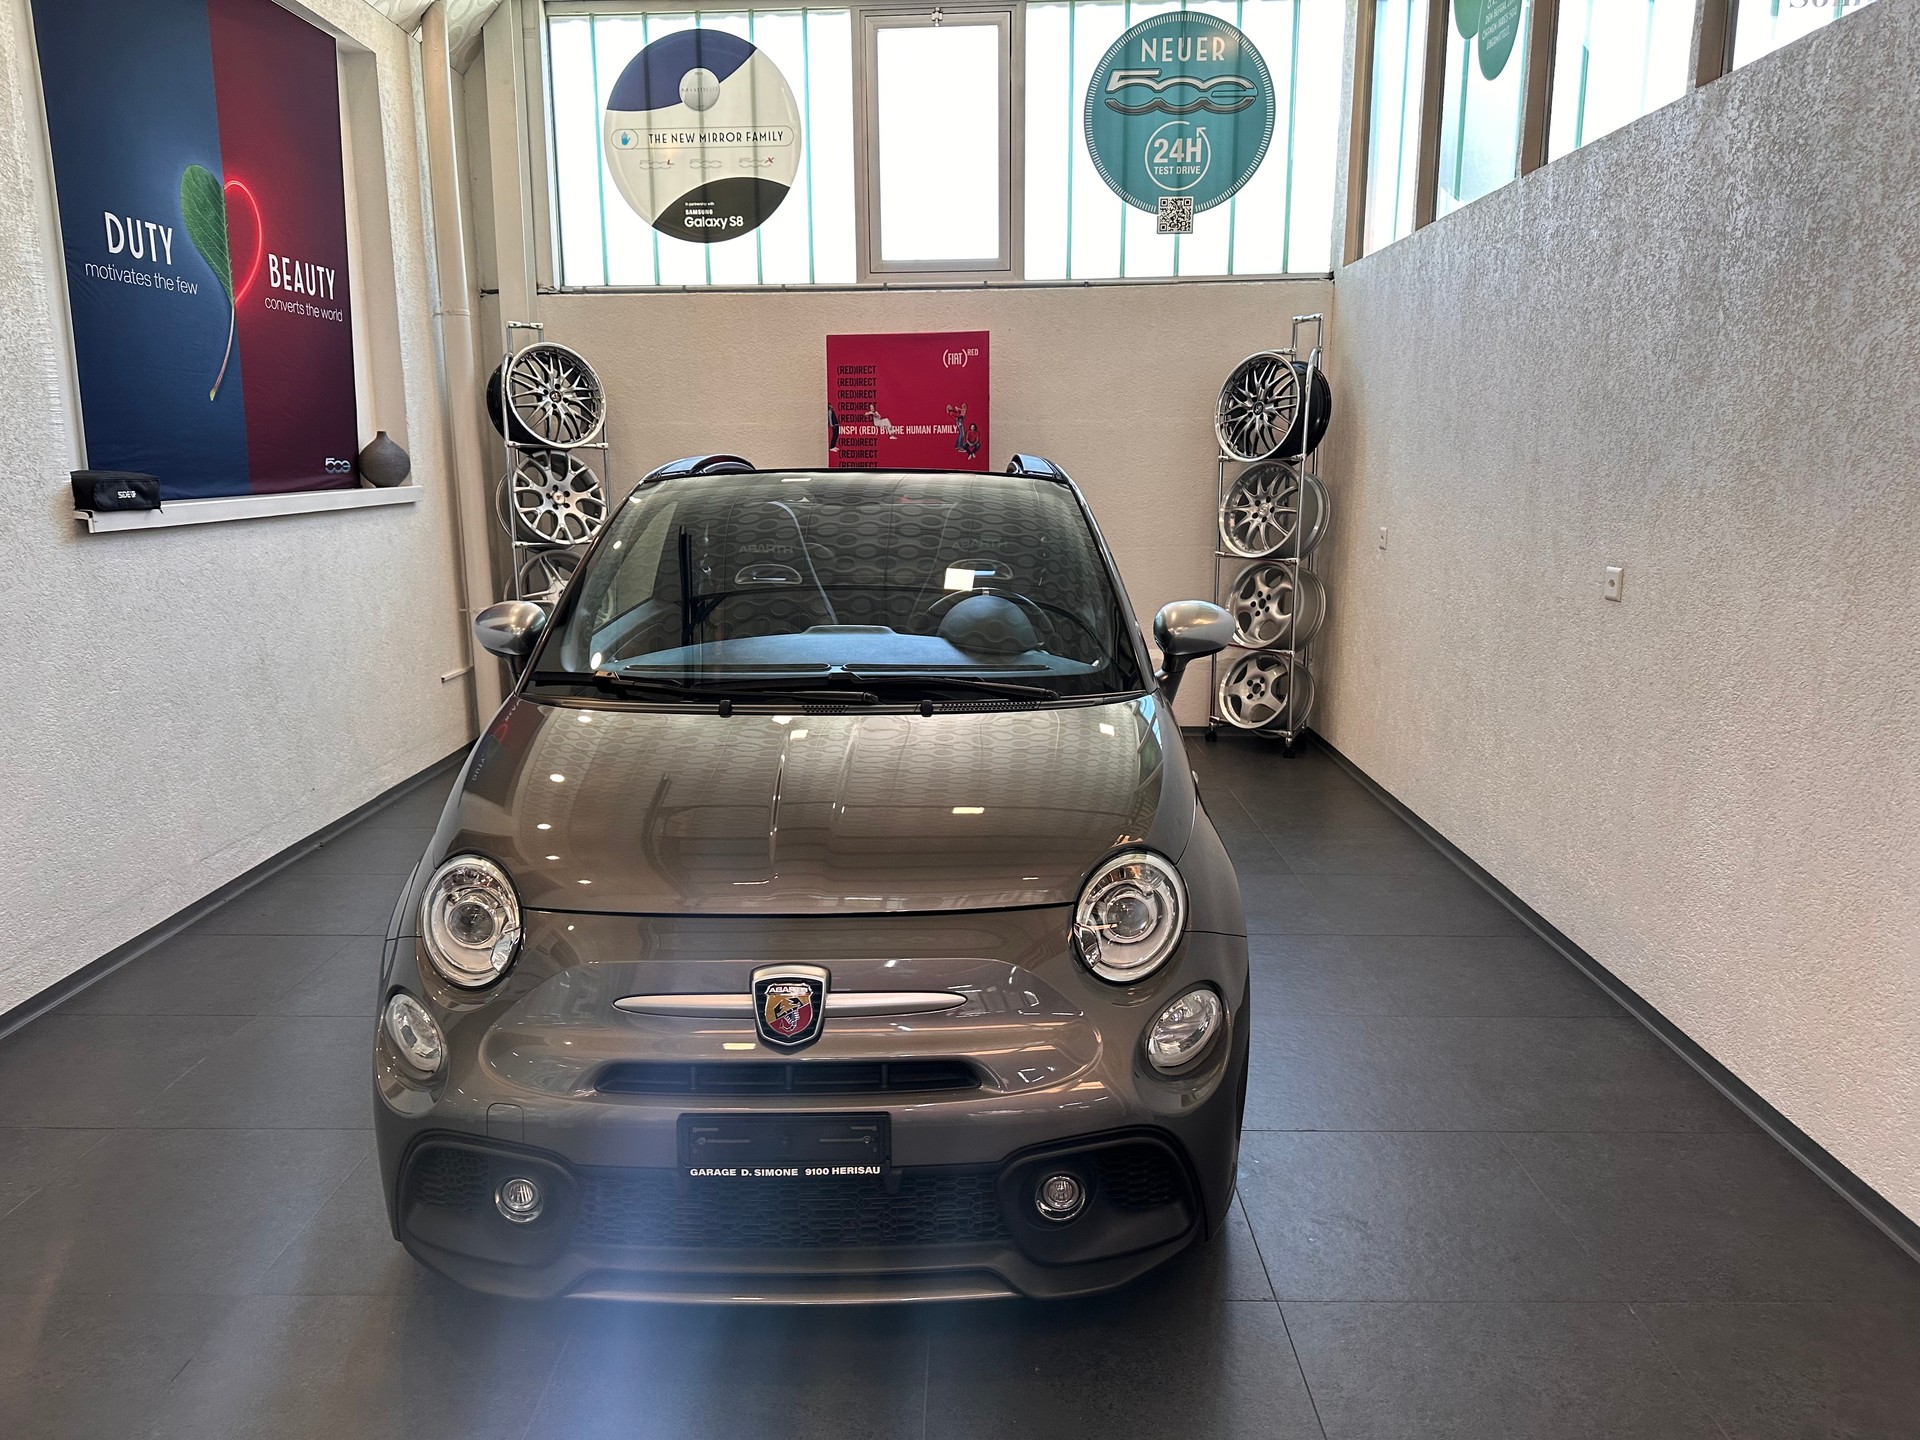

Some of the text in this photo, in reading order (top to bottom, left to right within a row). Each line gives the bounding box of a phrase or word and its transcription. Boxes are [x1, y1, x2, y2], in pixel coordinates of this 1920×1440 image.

[1141, 36, 1226, 63] NEUER
[648, 131, 783, 144] THE NEW MIRROR FAMILY
[1153, 137, 1202, 163] 24H
[1154, 166, 1201, 175] TEST DRIVE
[684, 216, 744, 230] Galaxy S8
[104, 211, 173, 265] DUTY
[85, 263, 198, 295] motivates the few
[268, 253, 335, 300] BEAUTY
[264, 297, 343, 322] converts the world
[967, 348, 979, 356] RED
[837, 365, 877, 375] (RED)IRECT
[837, 377, 877, 387] (RED)IRECT
[837, 389, 877, 399] (RED)IRECT
[838, 425, 858, 435] INSPI
[859, 425, 879, 436] (RED)
[906, 425, 932, 435] HUMAN
[838, 437, 878, 447] (RED)IRECT
[838, 449, 878, 459] (RED)IRECT
[690, 1166, 881, 1177] GARAGE D. SIMONE 9100 HERISAU
